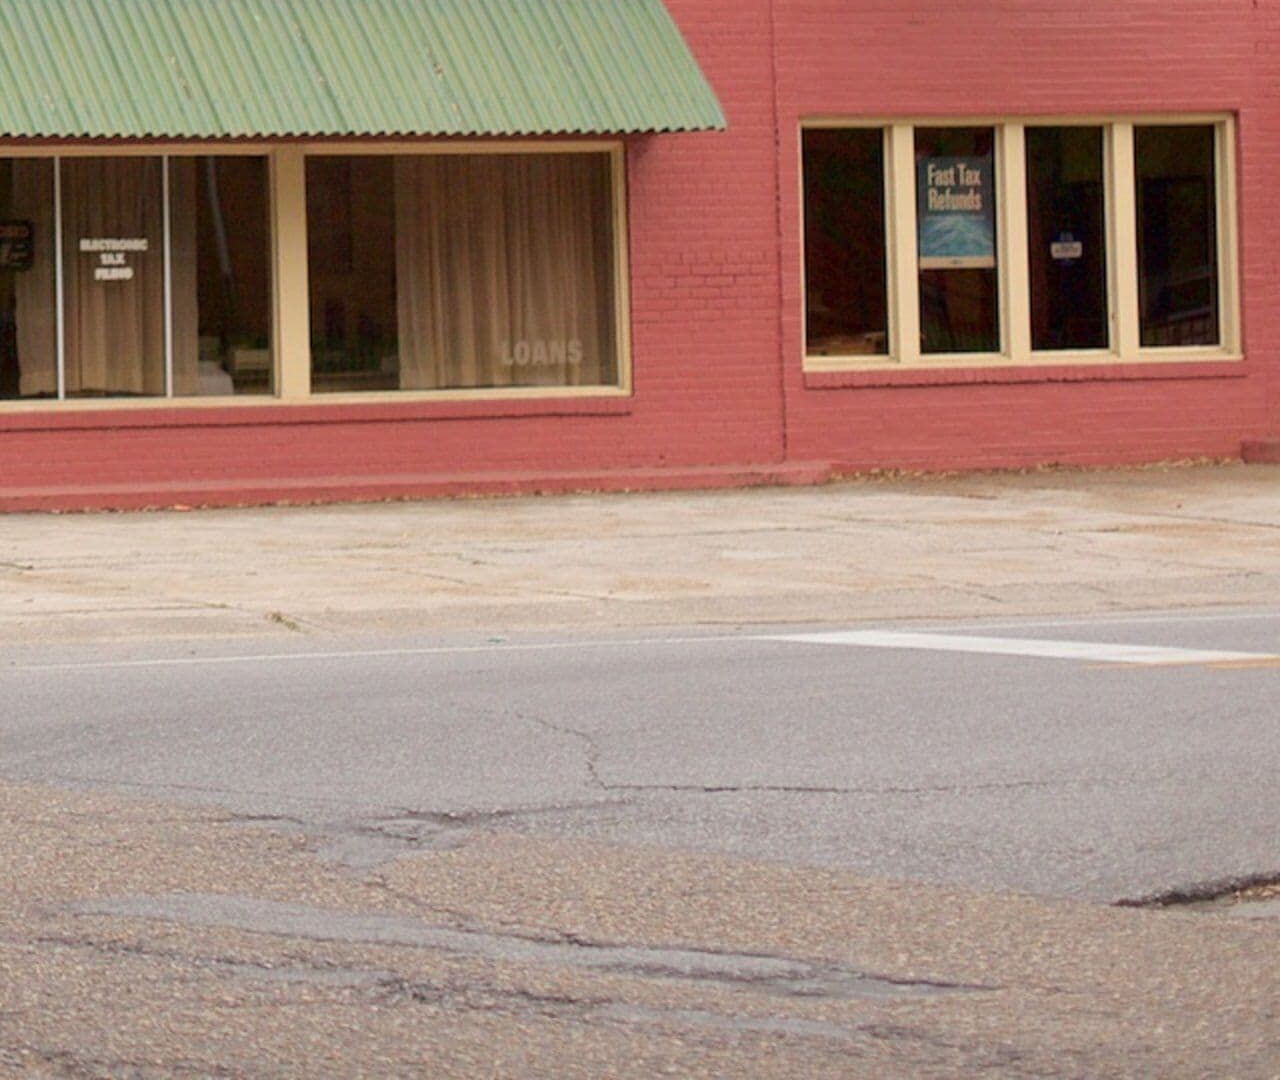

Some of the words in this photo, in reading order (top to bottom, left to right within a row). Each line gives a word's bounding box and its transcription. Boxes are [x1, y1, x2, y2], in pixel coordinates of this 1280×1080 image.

[928, 163, 955, 186] Fast
[957, 163, 981, 186] Tax
[928, 187, 982, 210] Refunds
[80, 238, 148, 251] ELECTRONIC
[100, 252, 125, 265] TAX
[501, 340, 583, 366] LOANS
